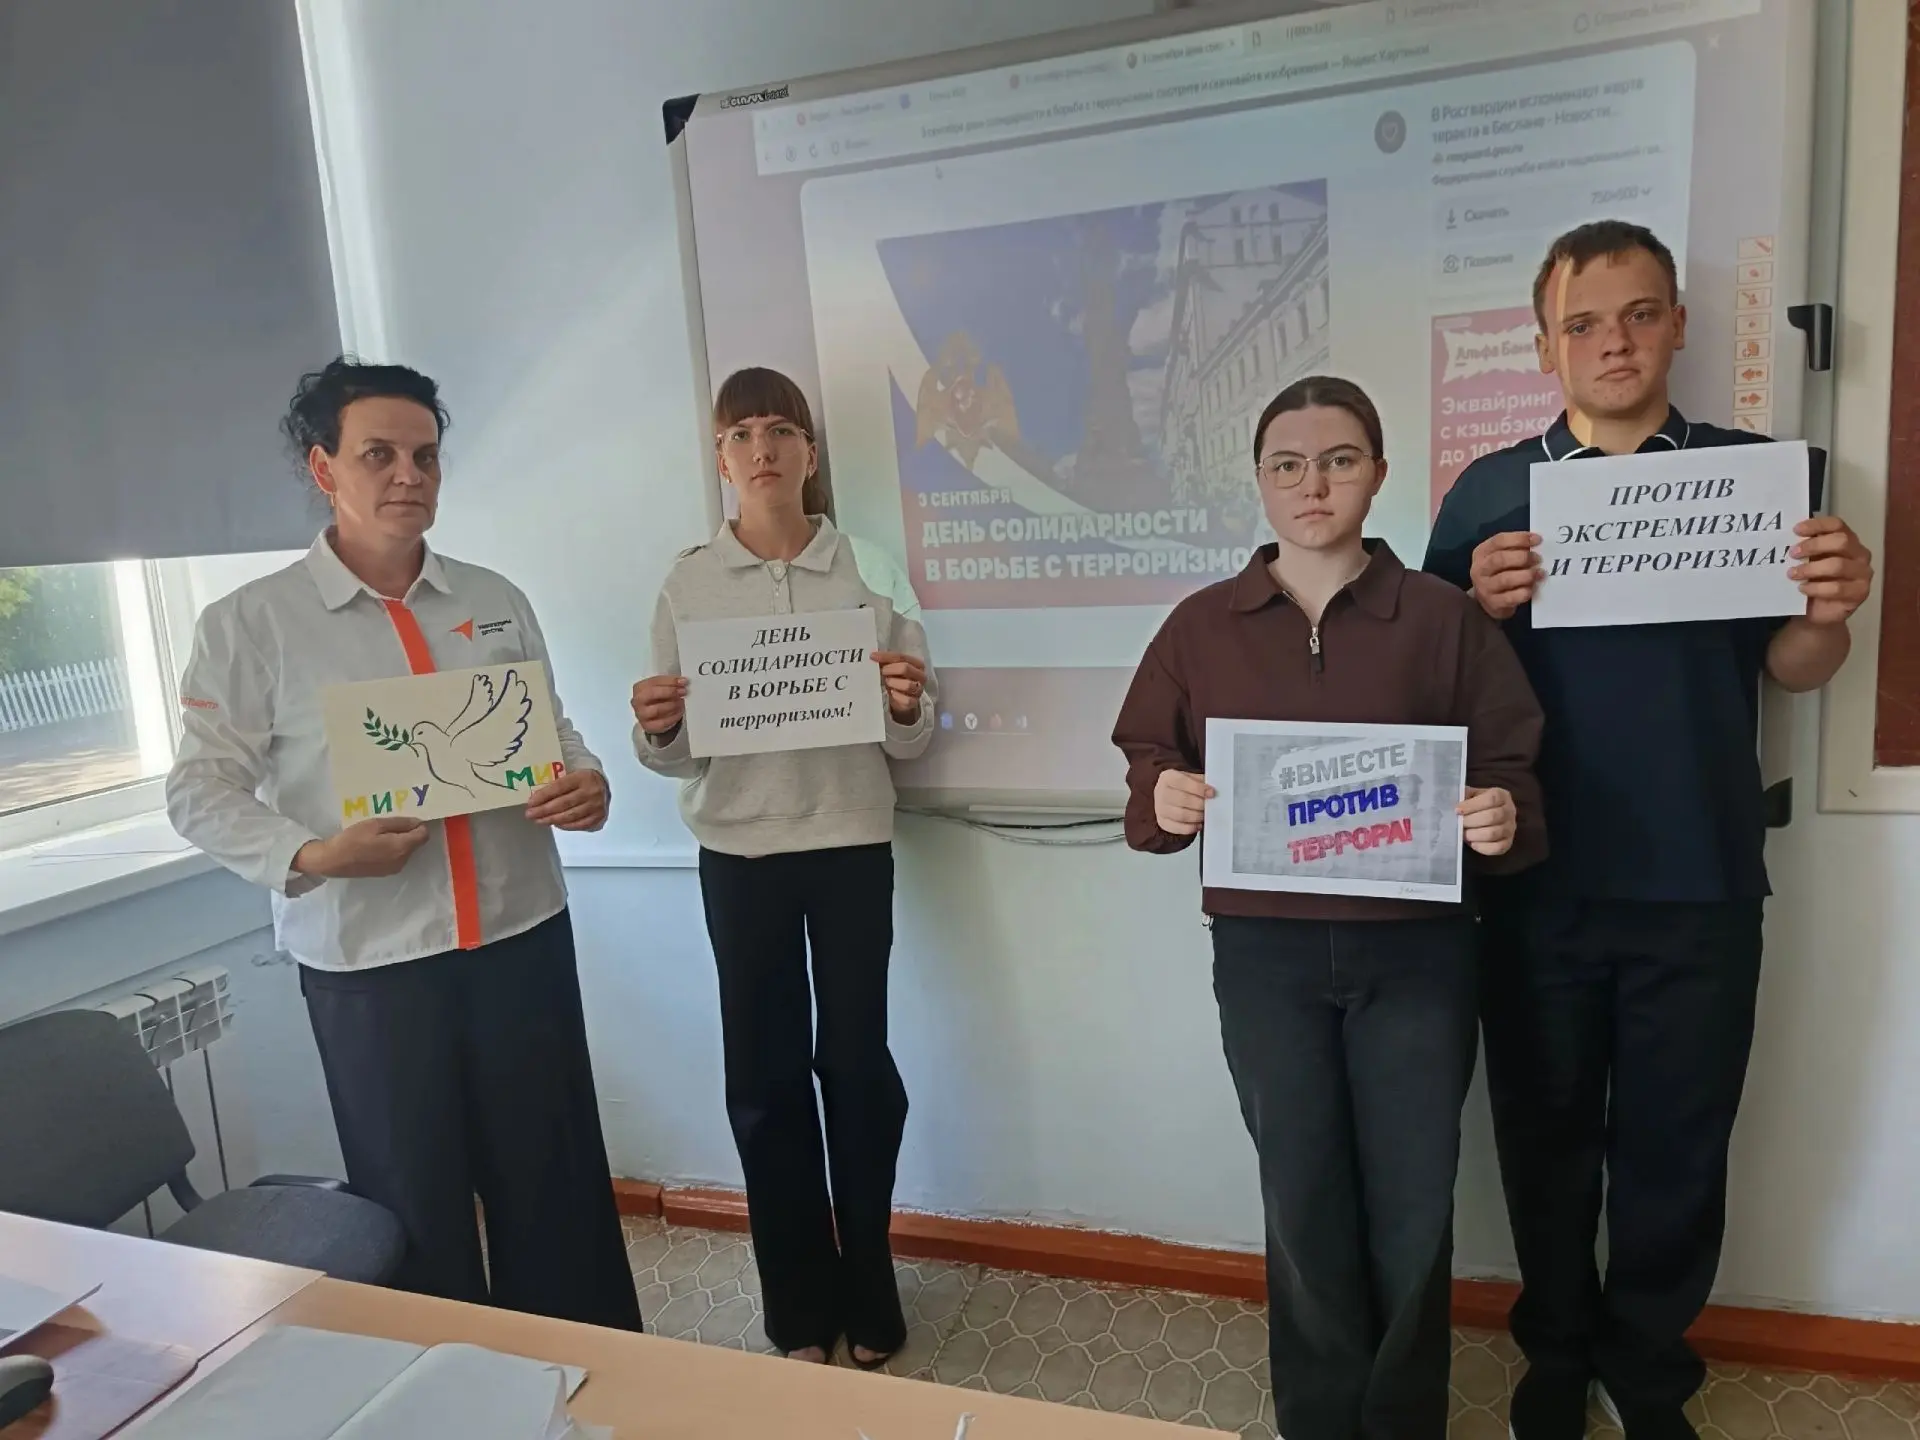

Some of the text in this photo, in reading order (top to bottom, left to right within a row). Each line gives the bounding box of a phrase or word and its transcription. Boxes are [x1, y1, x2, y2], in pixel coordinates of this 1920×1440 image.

[1431, 106, 1440, 122] В
[1442, 97, 1517, 121] Росгвардии
[1519, 84, 1599, 110] вспоминают
[1491, 116, 1546, 135] Беслане
[1441, 390, 1557, 415] Эквайринг
[1440, 426, 1451, 439] с
[1439, 448, 1465, 467] до
[918, 488, 1012, 507] 3 СЕНТЯБРЯ
[1607, 477, 1736, 506] ПРОТИВ
[921, 507, 1209, 548] ДЕНЬ СОЛИДАРНОСТИ
[1555, 510, 1783, 545] ЭКСТРЕМИЗМА
[924, 546, 1251, 582] В БОРЬБЕ С ТЕРРОРИЗМО
[1548, 544, 1791, 577] И ТЕРРОРИЗМА!
[750, 626, 811, 648] ДЕНЬ
[697, 648, 865, 677] СОЛИДАРНОСТИ
[727, 674, 849, 700] В БОРЬБЕ С
[719, 701, 854, 732] терроризмом!
[505, 761, 564, 790] МИР
[1278, 742, 1407, 790] #ВМЕСТЕ
[343, 783, 430, 818] МИРУ
[1287, 783, 1400, 827] ПРОТИВ
[1286, 816, 1413, 865] ТЕРРОРА!
